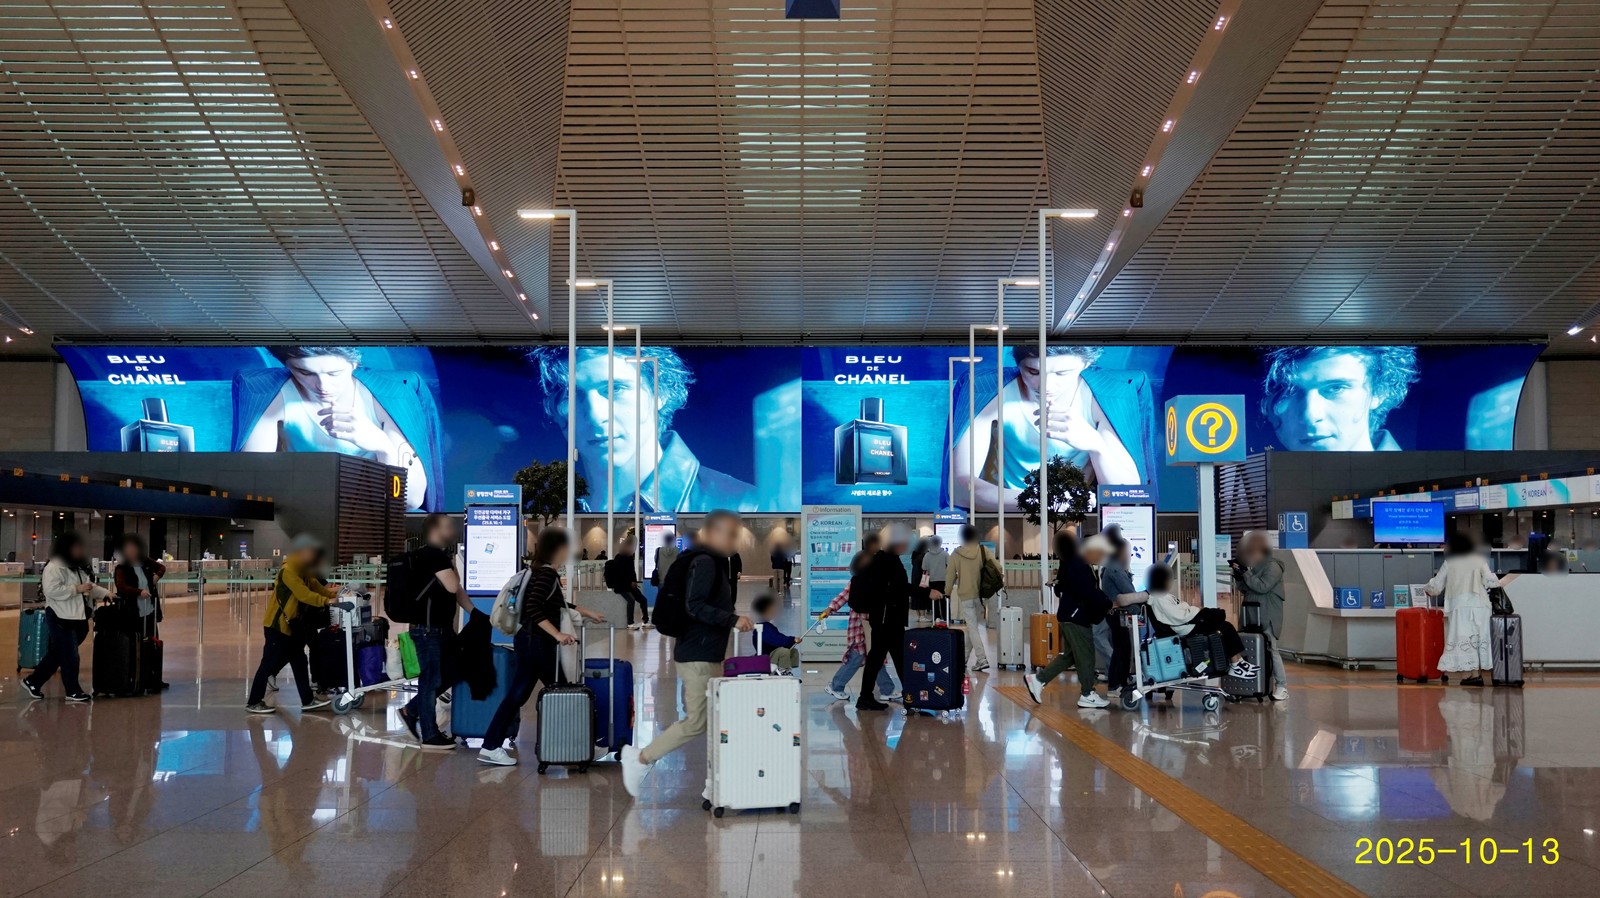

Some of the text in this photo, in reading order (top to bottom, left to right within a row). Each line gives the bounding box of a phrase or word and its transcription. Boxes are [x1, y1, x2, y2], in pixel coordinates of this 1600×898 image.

[107, 355, 166, 364] BLEU
[845, 355, 902, 364] BLEU
[107, 373, 186, 385] CHANEL
[834, 374, 910, 385] CHANEL
[873, 439, 892, 447] BLEU
[870, 449, 894, 457] CHANEL
[393, 475, 401, 498] D
[1528, 489, 1547, 497] KOREAN
